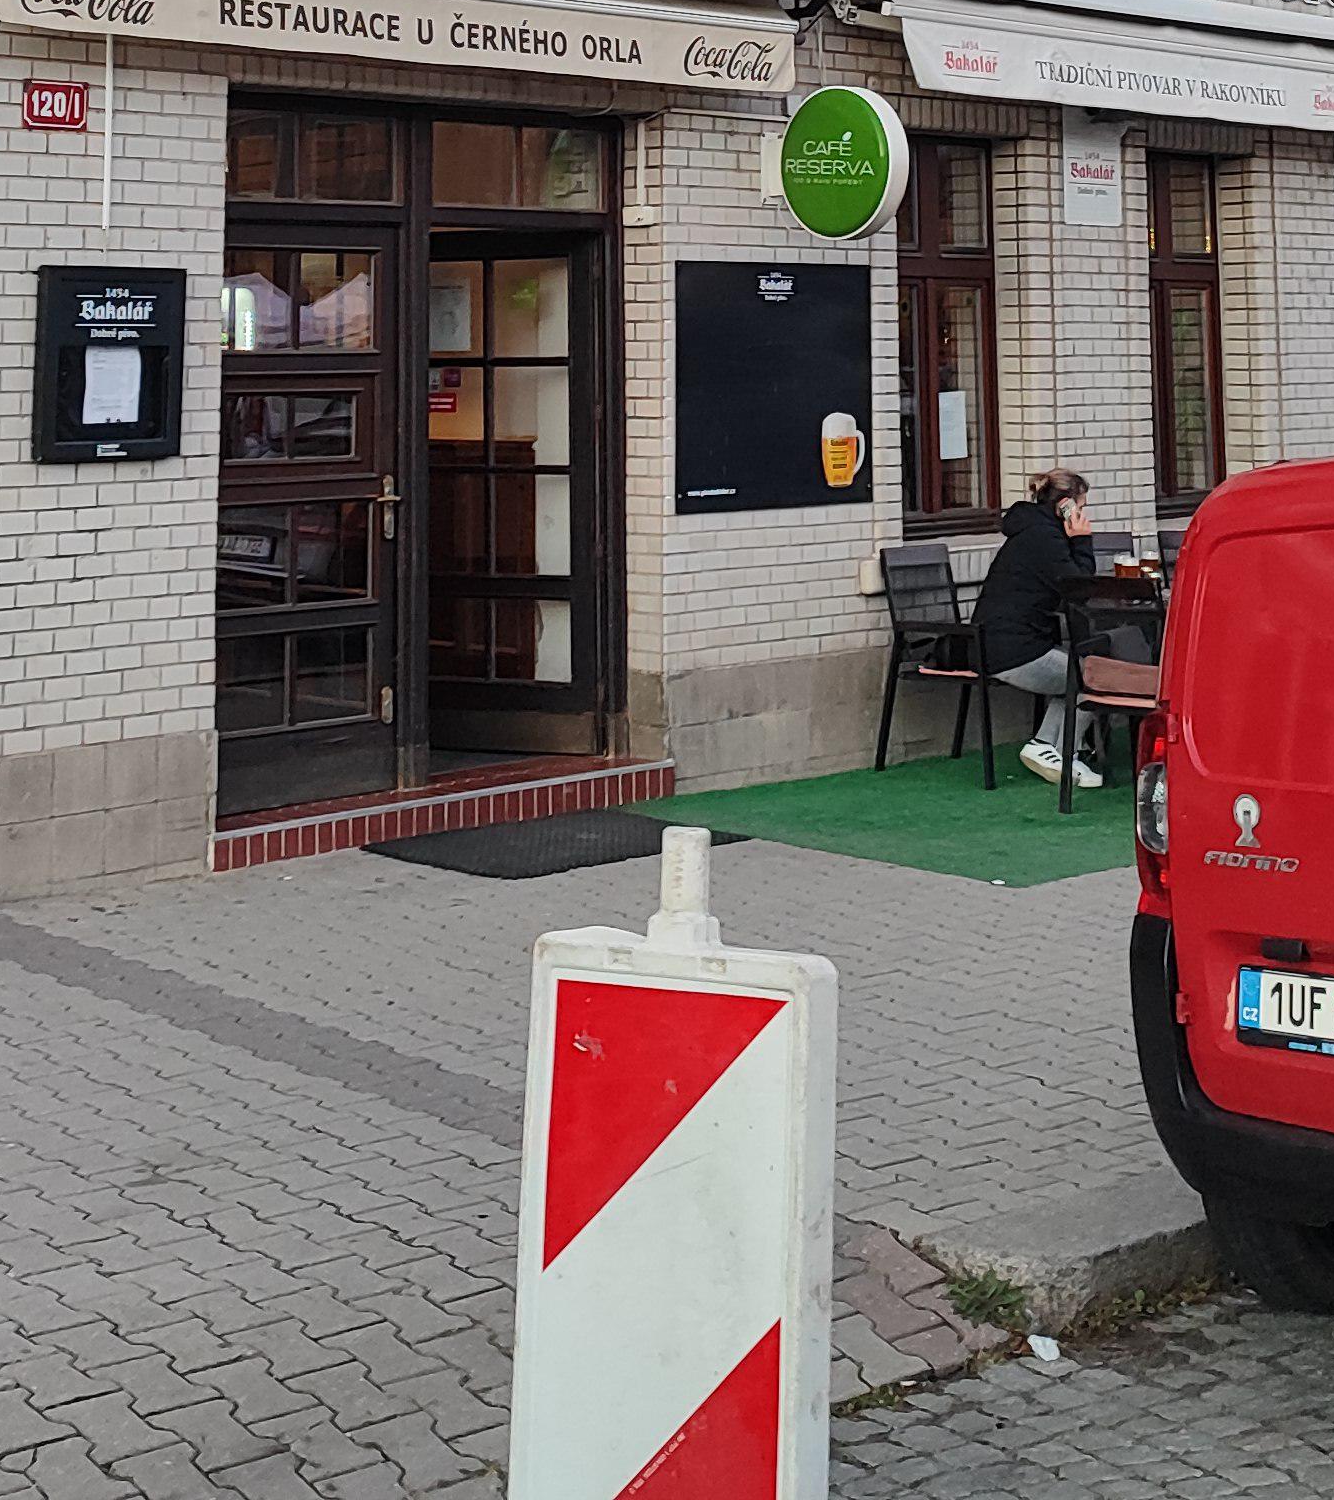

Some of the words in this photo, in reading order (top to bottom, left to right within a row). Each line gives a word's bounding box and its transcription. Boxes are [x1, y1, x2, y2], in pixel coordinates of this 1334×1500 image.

[416, 17, 434, 45] U
[449, 12, 568, 58] ČERNÉHO
[581, 34, 643, 64] ORLA
[683, 35, 777, 82] Coca-Cola
[944, 50, 998, 75] Bakalář
[1035, 61, 1114, 89] TRADIČNÍ
[1116, 70, 1183, 97] PIVOVAR
[1185, 79, 1198, 97] V
[1200, 80, 1287, 107] RAKOVNÍKU
[802, 131, 853, 157] CAFÉ
[785, 159, 875, 176] RESERVA
[1070, 162, 1115, 180] Bakalář
[78, 300, 154, 320] Bakalář
[1242, 1006, 1260, 1022] CZ
[1270, 982, 1327, 1030] 1UF
